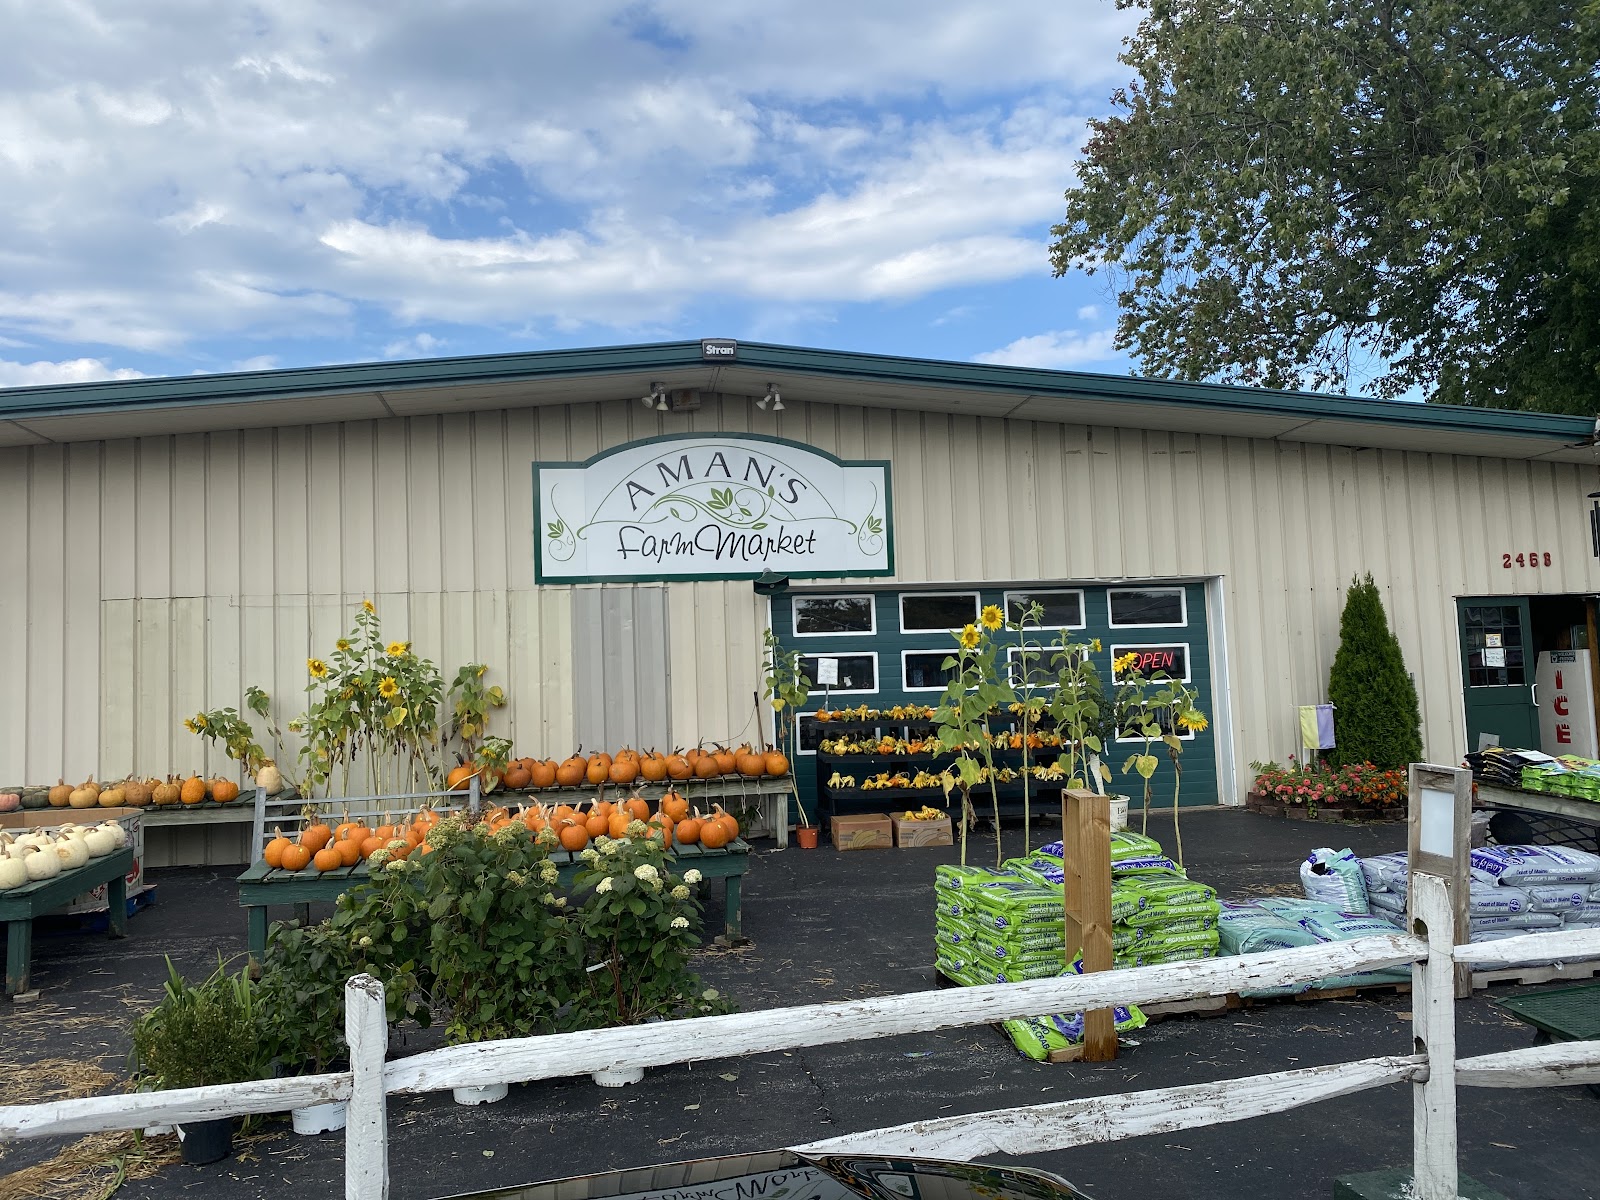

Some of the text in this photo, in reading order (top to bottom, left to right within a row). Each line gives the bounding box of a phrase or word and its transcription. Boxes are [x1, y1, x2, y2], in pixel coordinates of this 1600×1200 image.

[706, 345, 734, 354] Stran
[625, 452, 807, 512] AMAN'S
[617, 524, 816, 563] Farm Market
[1503, 552, 1551, 568] 2468
[1132, 652, 1173, 670] OPEN
[1554, 669, 1571, 743] ICE
[1035, 1031, 1050, 1050] CRAB
